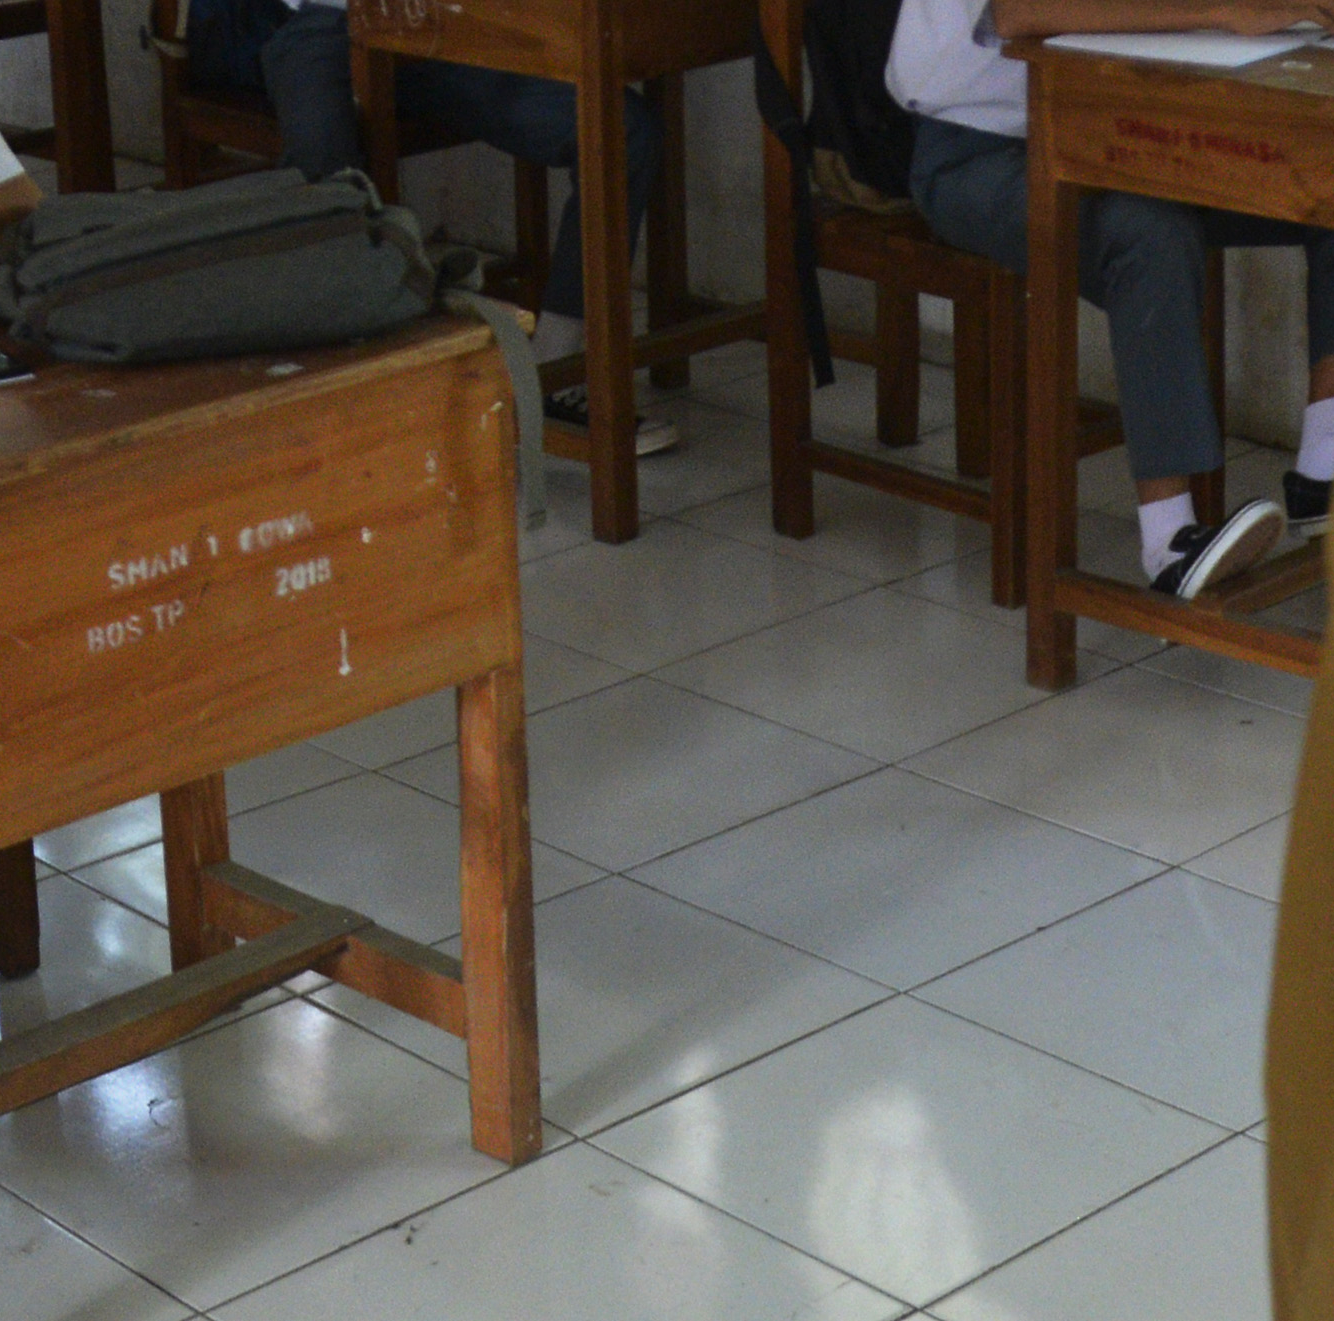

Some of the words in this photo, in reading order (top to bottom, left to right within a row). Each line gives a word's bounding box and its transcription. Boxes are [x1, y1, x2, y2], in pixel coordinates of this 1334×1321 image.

[107, 541, 189, 591] SMAN
[206, 534, 218, 557] 1
[86, 613, 144, 652] BOS
[149, 598, 185, 630] TP
